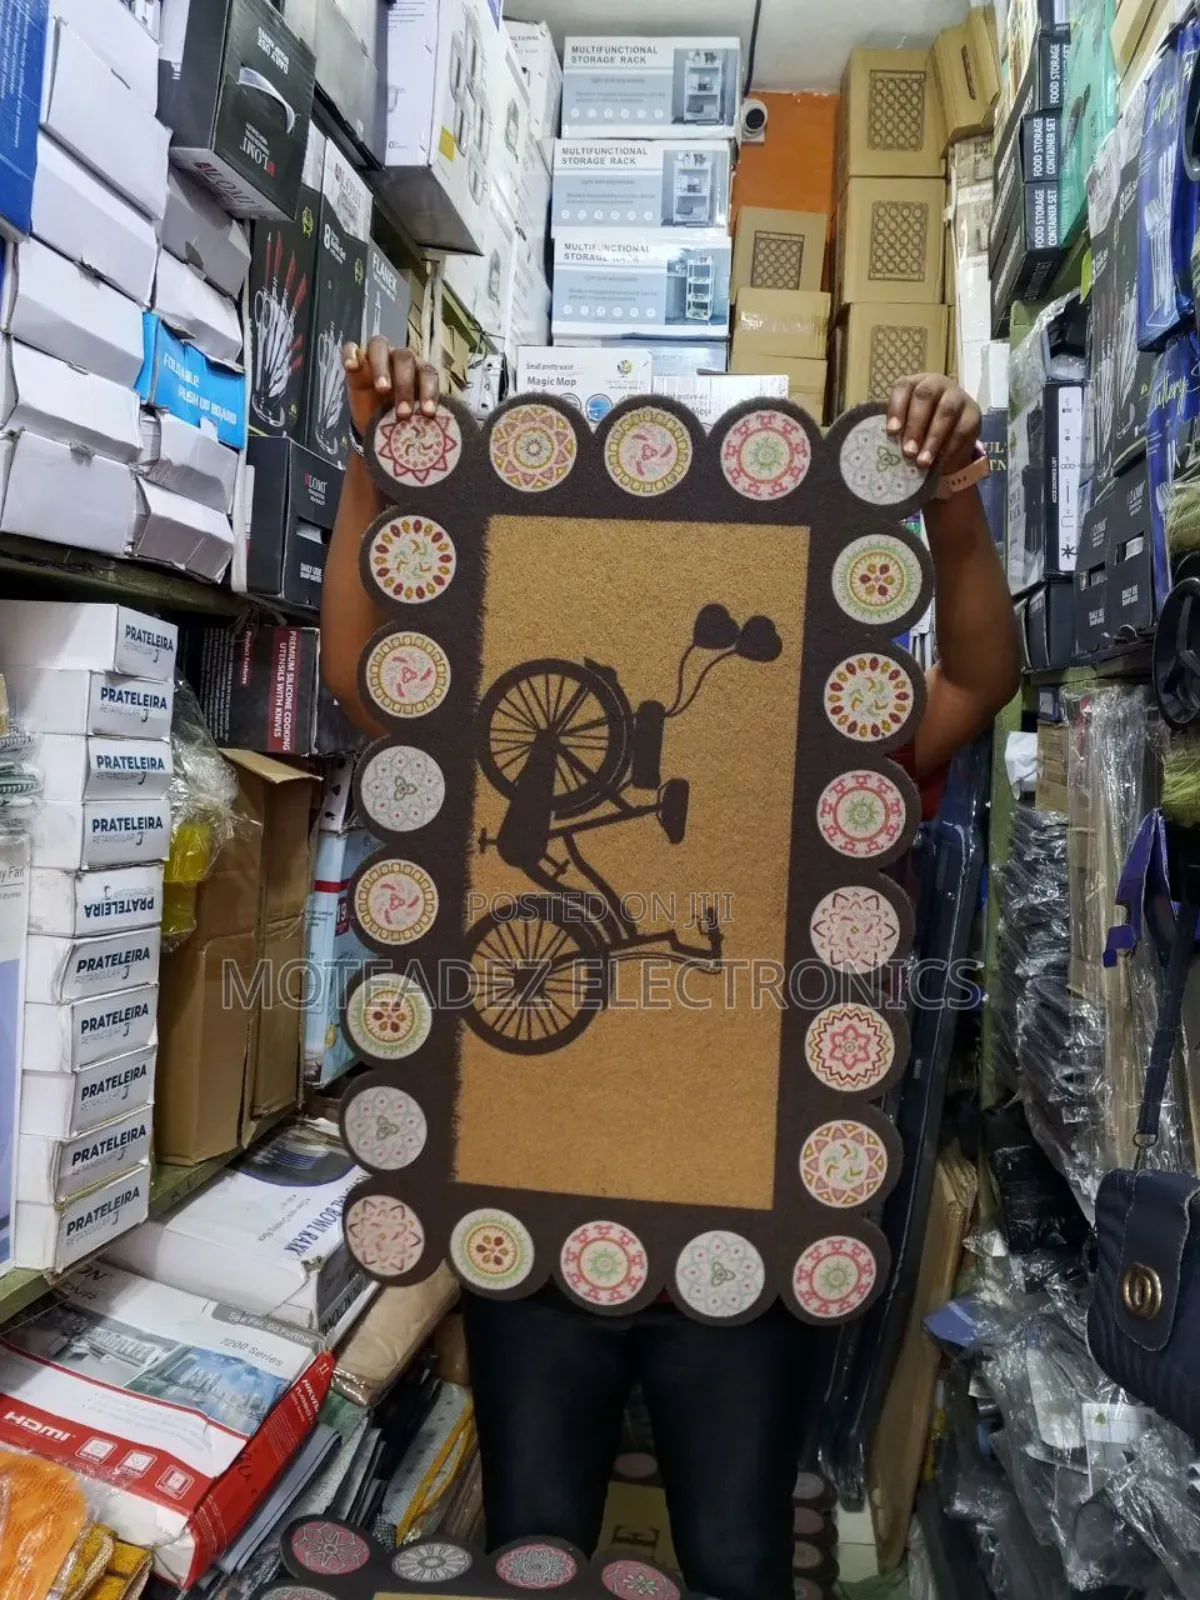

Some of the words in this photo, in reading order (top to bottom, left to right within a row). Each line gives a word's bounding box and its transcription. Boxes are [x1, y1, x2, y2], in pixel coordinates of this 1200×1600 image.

[571, 46, 658, 55] MULTIFUNCTIONAL
[571, 55, 615, 64] STORAGE
[1050, 43, 1060, 80] STORAGE
[1050, 80, 1060, 104] FOOD
[1033, 117, 1044, 154] STORAGE
[1046, 117, 1056, 133] SET
[562, 147, 648, 156] MULTIFUNCTIONAL
[562, 157, 606, 165] STORAGE
[1046, 133, 1056, 175] CONTAINER
[1033, 154, 1044, 177] FOOD
[1035, 189, 1045, 226] STORAGE
[1048, 189, 1057, 204] SET
[1035, 226, 1044, 249] FOOD
[1048, 204, 1056, 246] CONTAINER
[527, 376, 555, 387] Magic
[555, 377, 577, 387] Mop
[125, 624, 174, 651] PRATELEIRA
[277, 642, 287, 682] UTENSILS
[286, 631, 297, 671] PREMIUM
[101, 687, 167, 710] PRATELEIRA
[275, 683, 285, 706] WITH
[284, 672, 295, 710] SILICONE
[274, 708, 283, 737] KNIVES
[282, 713, 292, 751] COOKING
[96, 755, 165, 770] PRATELEIRA
[92, 816, 163, 833] PRATELEIRA
[84, 896, 155, 918] PRATELEIRA
[76, 947, 151, 973] PRATELEIRA
[81, 1003, 149, 1034] PRATELEIRA
[81, 1064, 147, 1101] PRATELEIRA
[72, 1124, 146, 1167] PRATELEIRA
[66, 1186, 140, 1237] PRATELEIRA
[307, 1205, 343, 1234] BOWL
[248, 1344, 283, 1368] Series
